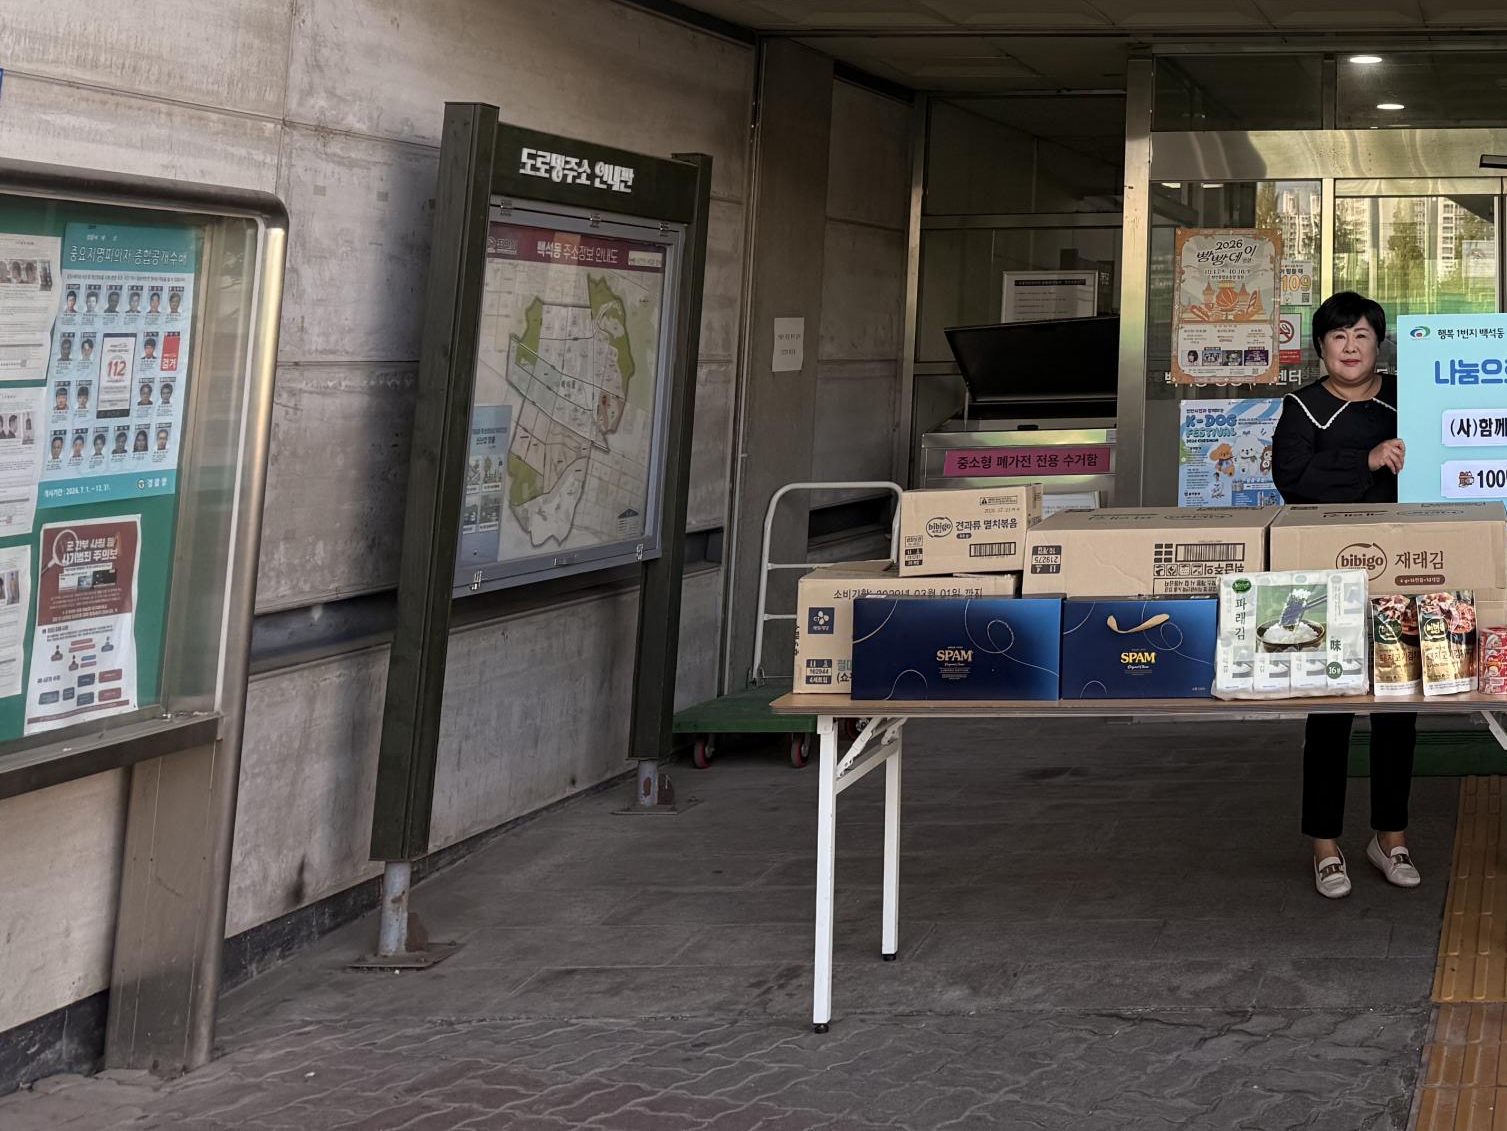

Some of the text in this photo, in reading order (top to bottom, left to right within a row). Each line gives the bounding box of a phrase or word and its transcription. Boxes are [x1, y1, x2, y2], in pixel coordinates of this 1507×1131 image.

[519, 147, 634, 193] 도로명주소 안내판
[537, 240, 562, 258] 백석동
[1215, 239, 1243, 251] 2026
[1282, 274, 1312, 292] 109
[1438, 327, 1504, 340] 행복 1번지 백석동
[107, 361, 126, 377] 112
[1185, 414, 1237, 428] K-DOG
[1186, 427, 1237, 438] FESTIVAL
[958, 456, 992, 469] 중소형
[1036, 454, 1059, 468] 전용
[1063, 453, 1098, 467] 수거함
[928, 522, 951, 532] bibigo
[956, 518, 1017, 531] 견과류 멸치볶음
[1034, 556, 1058, 564] 219275
[1341, 550, 1445, 570] bibigo 재래김
[1235, 597, 1247, 641] 파래김
[1330, 639, 1342, 652] 味
[936, 649, 973, 662] SPAM
[1121, 651, 1156, 663] SPAM
